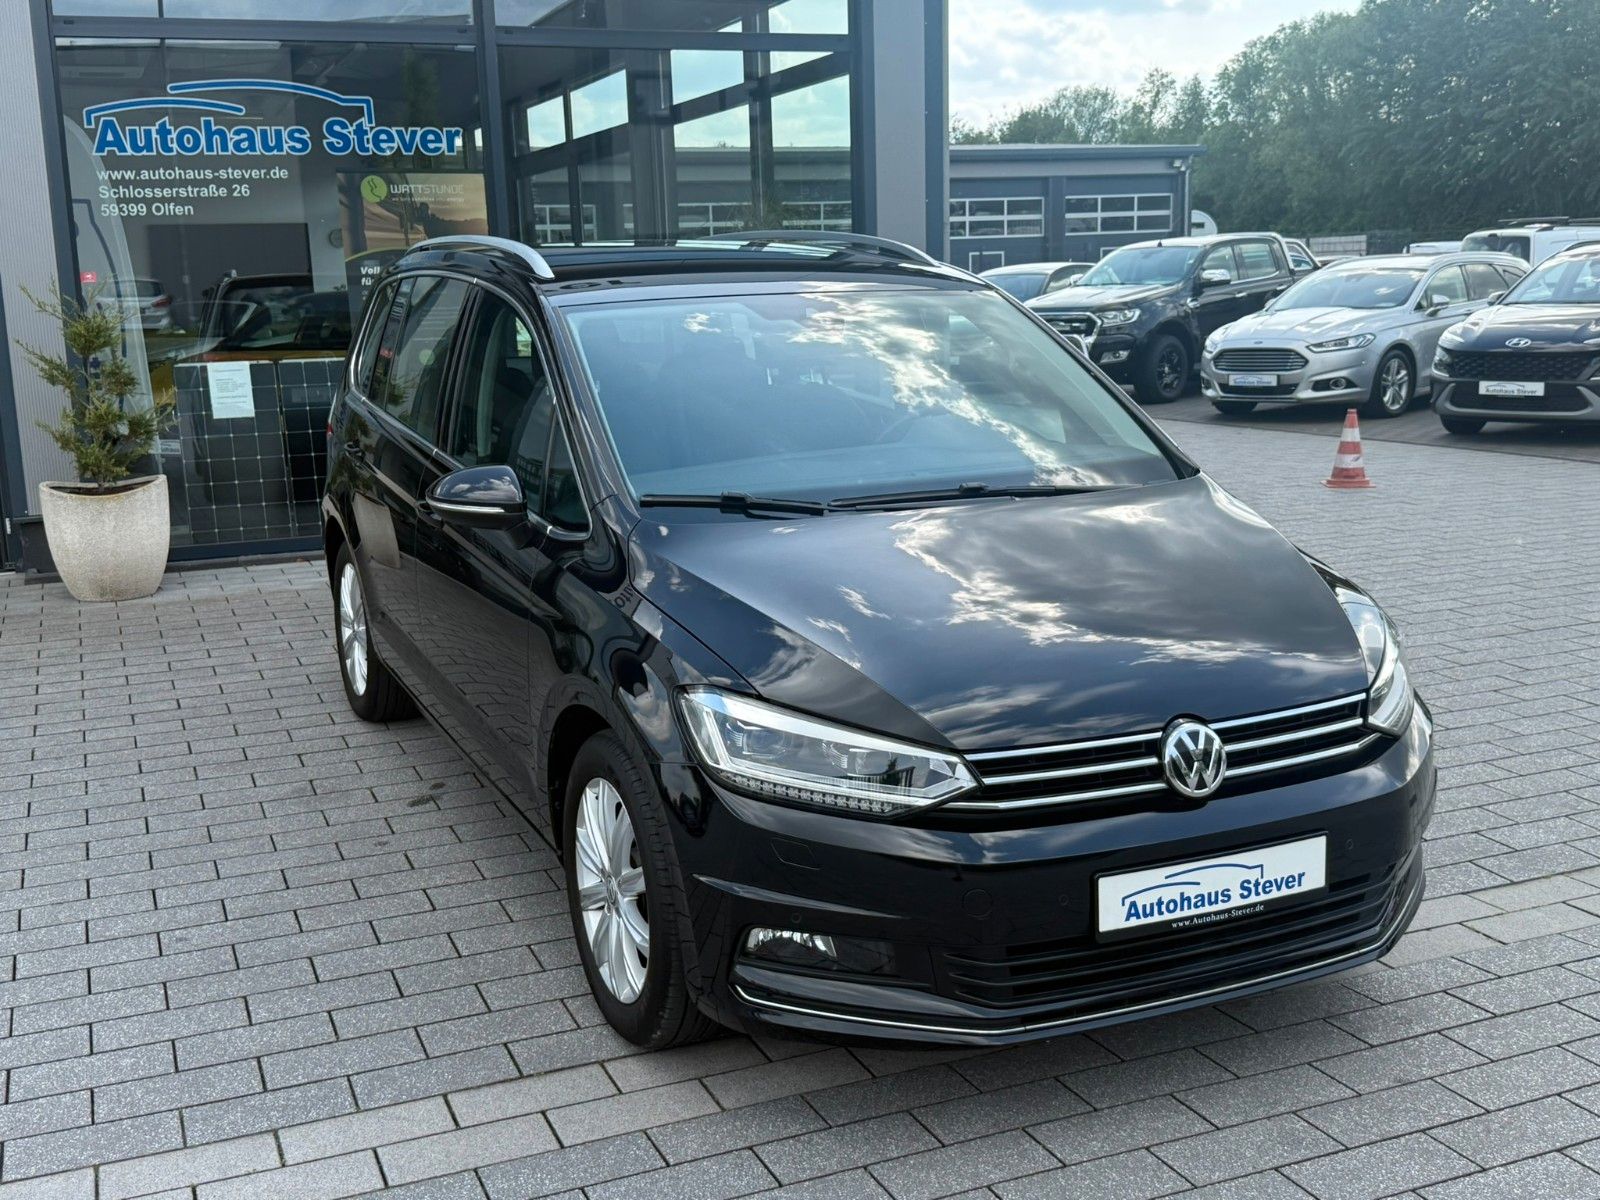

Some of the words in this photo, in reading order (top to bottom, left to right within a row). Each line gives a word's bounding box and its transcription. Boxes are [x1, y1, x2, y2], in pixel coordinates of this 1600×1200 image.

[93, 117, 311, 156] Autohaus
[322, 117, 462, 156] Stever
[97, 166, 289, 181] www.autohaus-stever.de
[98, 184, 228, 199] Schlosserstraße
[231, 184, 250, 198] 26
[100, 203, 147, 217] 59399
[151, 202, 194, 216] Olfen
[1124, 887, 1231, 922] Autohaus
[1239, 871, 1306, 900] Stever
[1171, 903, 1265, 928] www.Autohaus-Stever.de
